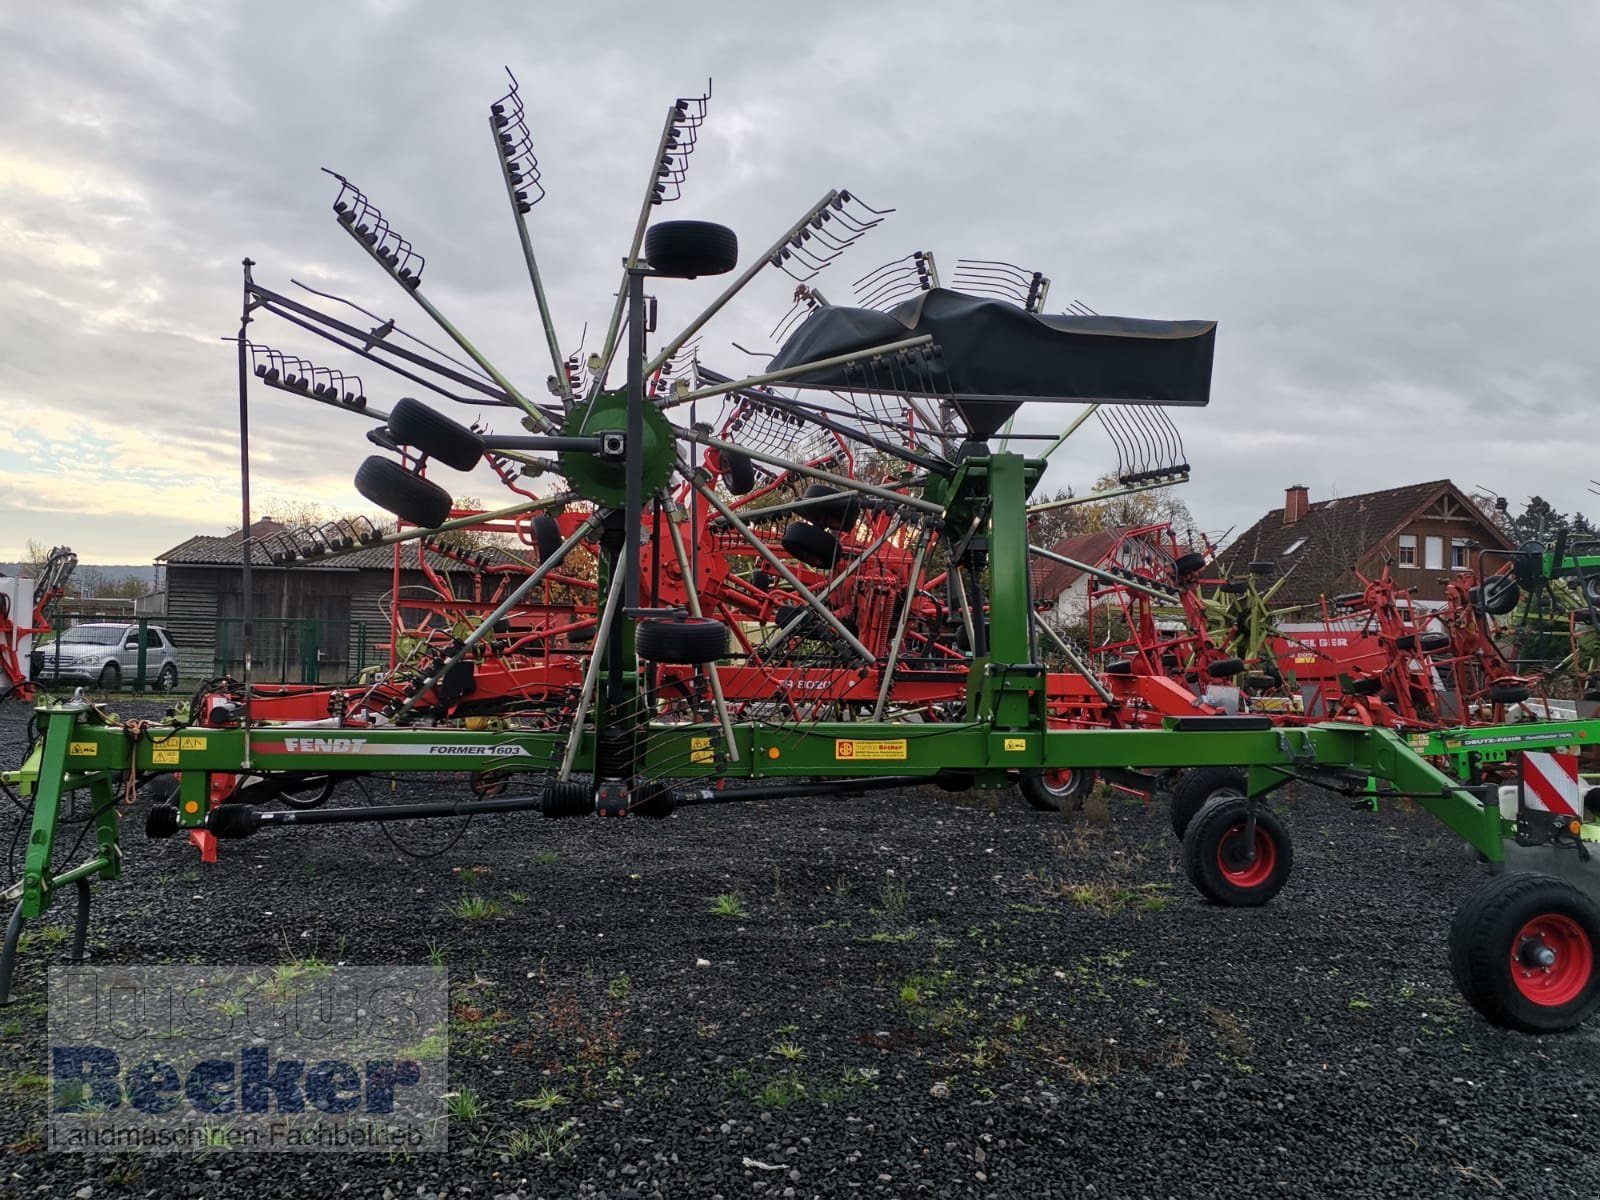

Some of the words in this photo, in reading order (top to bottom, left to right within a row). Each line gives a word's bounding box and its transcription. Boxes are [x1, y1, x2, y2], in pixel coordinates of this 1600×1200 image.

[1286, 638, 1348, 648] WELGER
[284, 738, 367, 752] FENDT
[1464, 736, 1522, 746] DEUTZ-FAHR
[429, 746, 486, 755] FORMER
[490, 746, 520, 755] 1603
